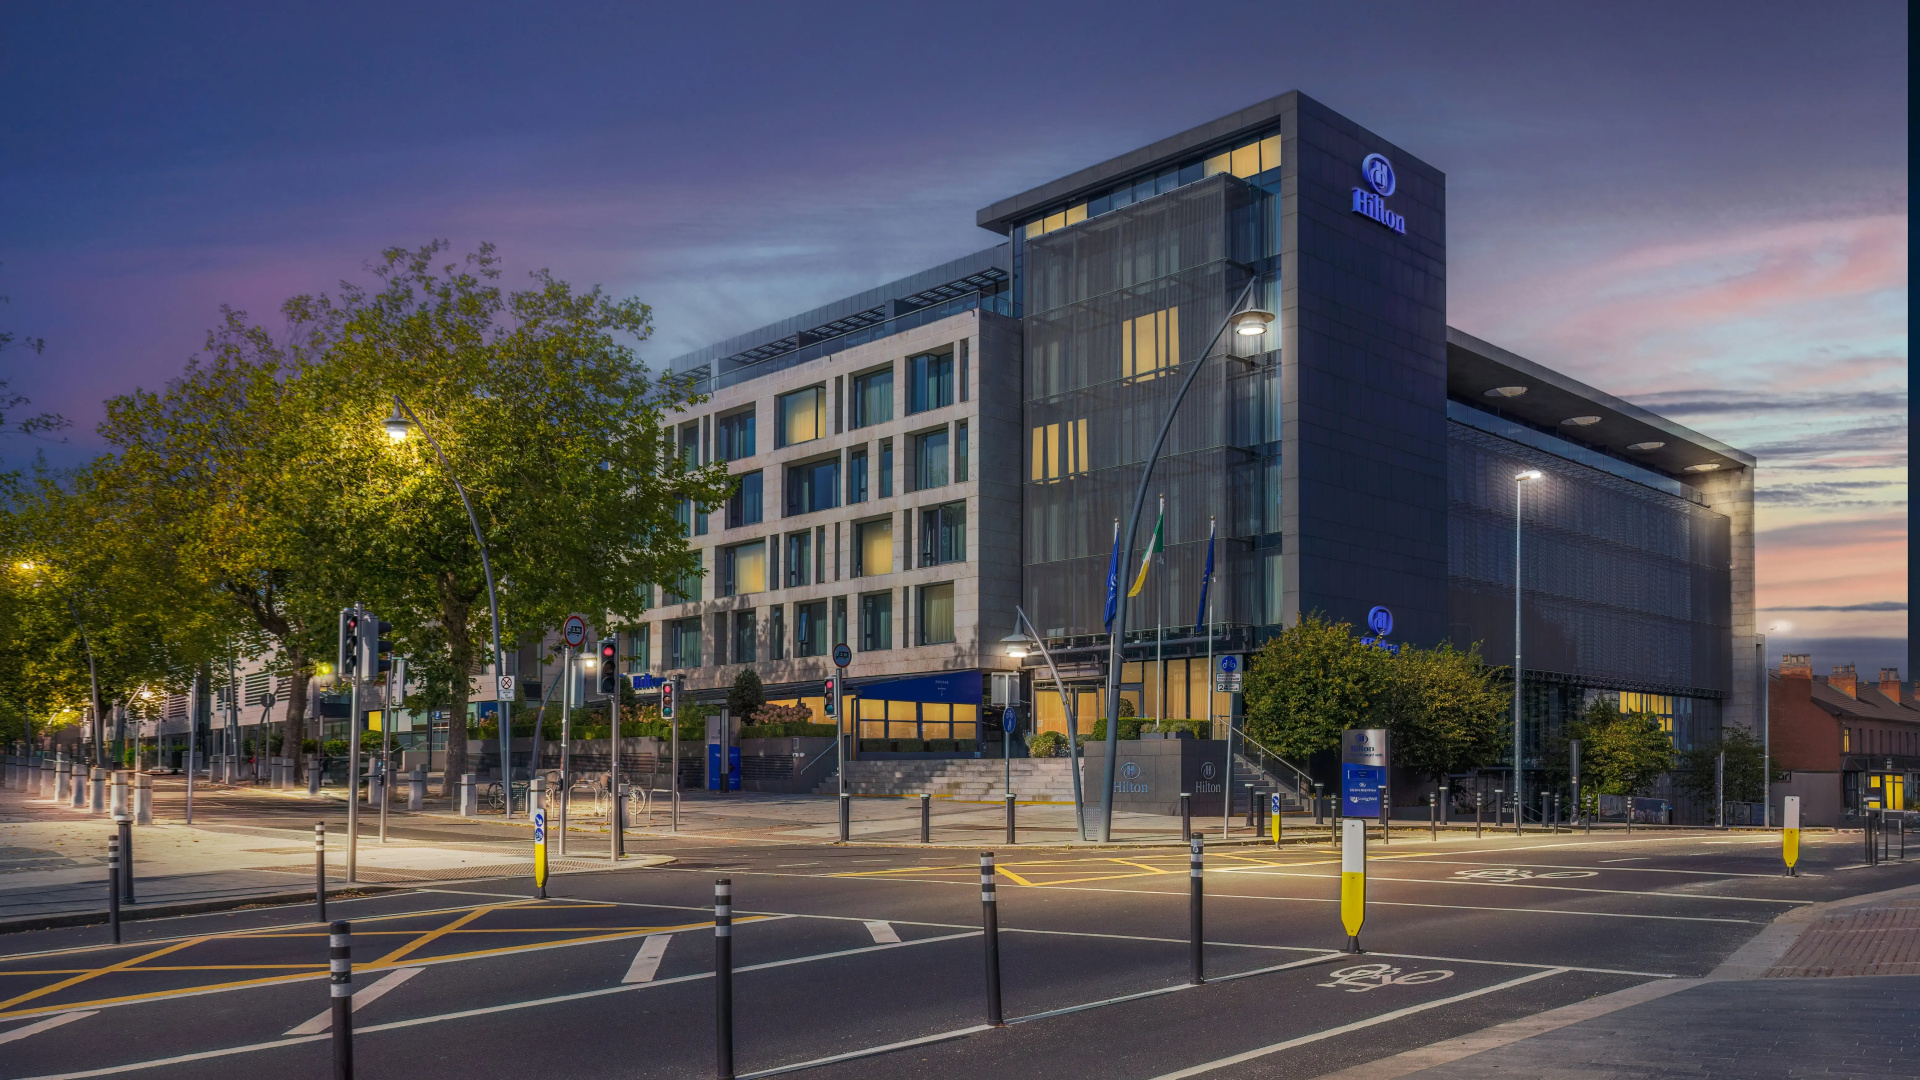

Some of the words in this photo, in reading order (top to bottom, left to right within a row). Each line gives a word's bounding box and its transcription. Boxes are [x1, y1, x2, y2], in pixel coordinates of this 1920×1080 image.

[1352, 187, 1406, 234] Hilton
[1113, 781, 1149, 793] Hilton
[1195, 781, 1221, 793] Hilton
